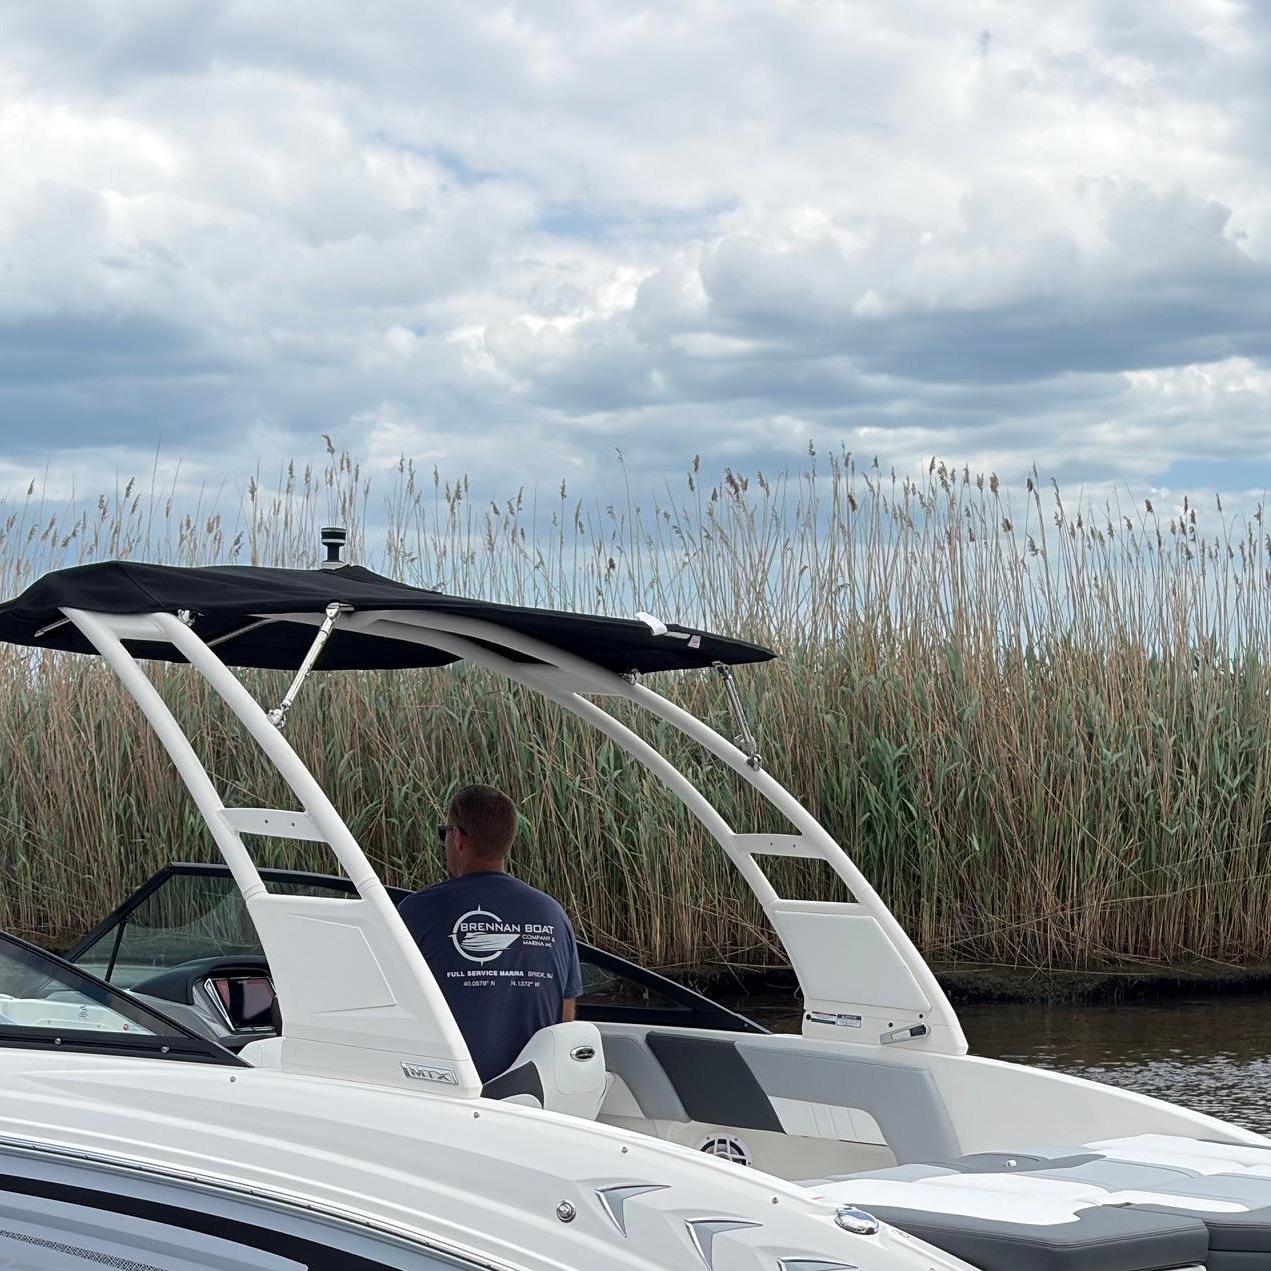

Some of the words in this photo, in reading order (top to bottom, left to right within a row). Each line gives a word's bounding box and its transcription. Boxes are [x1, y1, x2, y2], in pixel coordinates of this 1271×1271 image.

[460, 922, 520, 933] BRENNAN
[525, 924, 554, 934] BOAT
[410, 1068, 450, 1082] MTX
